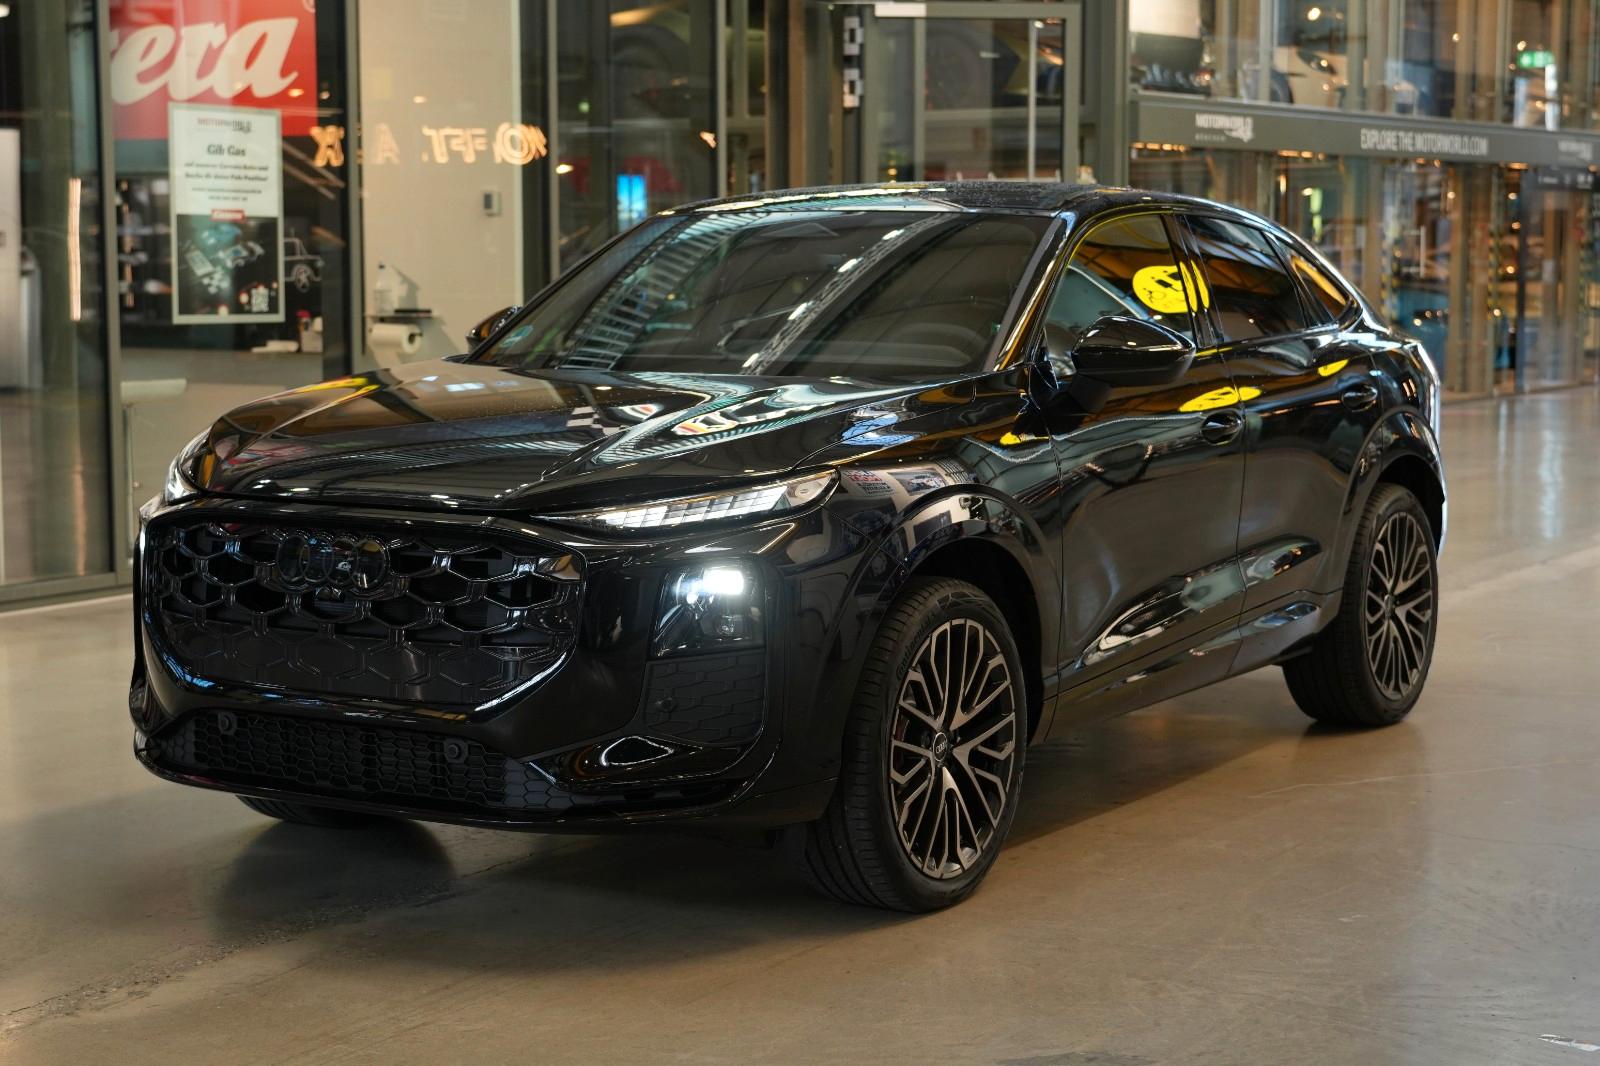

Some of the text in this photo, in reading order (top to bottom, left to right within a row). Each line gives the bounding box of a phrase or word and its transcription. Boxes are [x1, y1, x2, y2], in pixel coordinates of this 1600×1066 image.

[1195, 113, 1253, 129] MOTORWORLD
[1360, 127, 1488, 155] EXPLORE THE MOTORWORLD.COM
[227, 145, 247, 157] Gas
